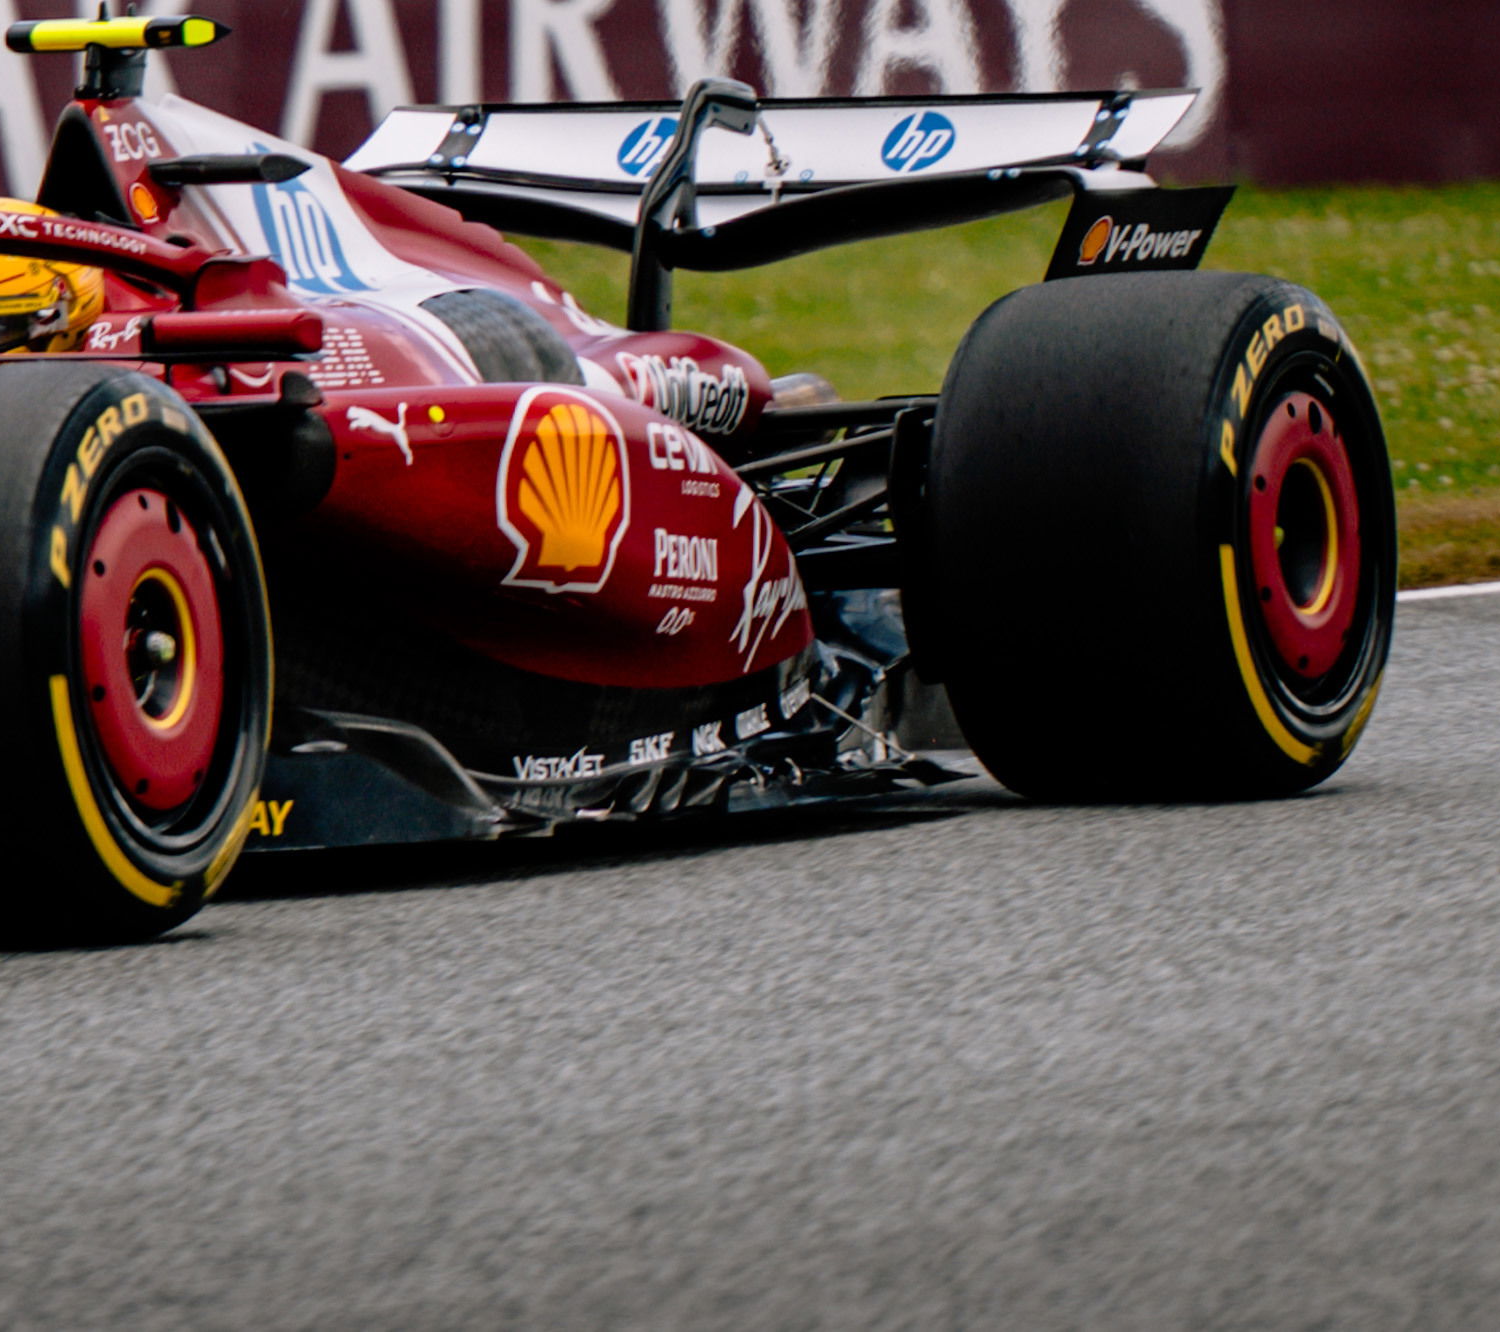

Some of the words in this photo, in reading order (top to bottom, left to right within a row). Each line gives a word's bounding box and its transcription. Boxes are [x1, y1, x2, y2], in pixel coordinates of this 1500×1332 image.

[884, 111, 954, 172] hp
[42, 221, 148, 255] TECHNOLOGY
[1105, 222, 1200, 265] V-Power
[1230, 303, 1305, 421] ZERO
[61, 391, 149, 525] ZERO
[50, 526, 73, 590] P
[653, 527, 719, 582] PERONI
[629, 731, 675, 765] SKF
[249, 799, 295, 836] AY
